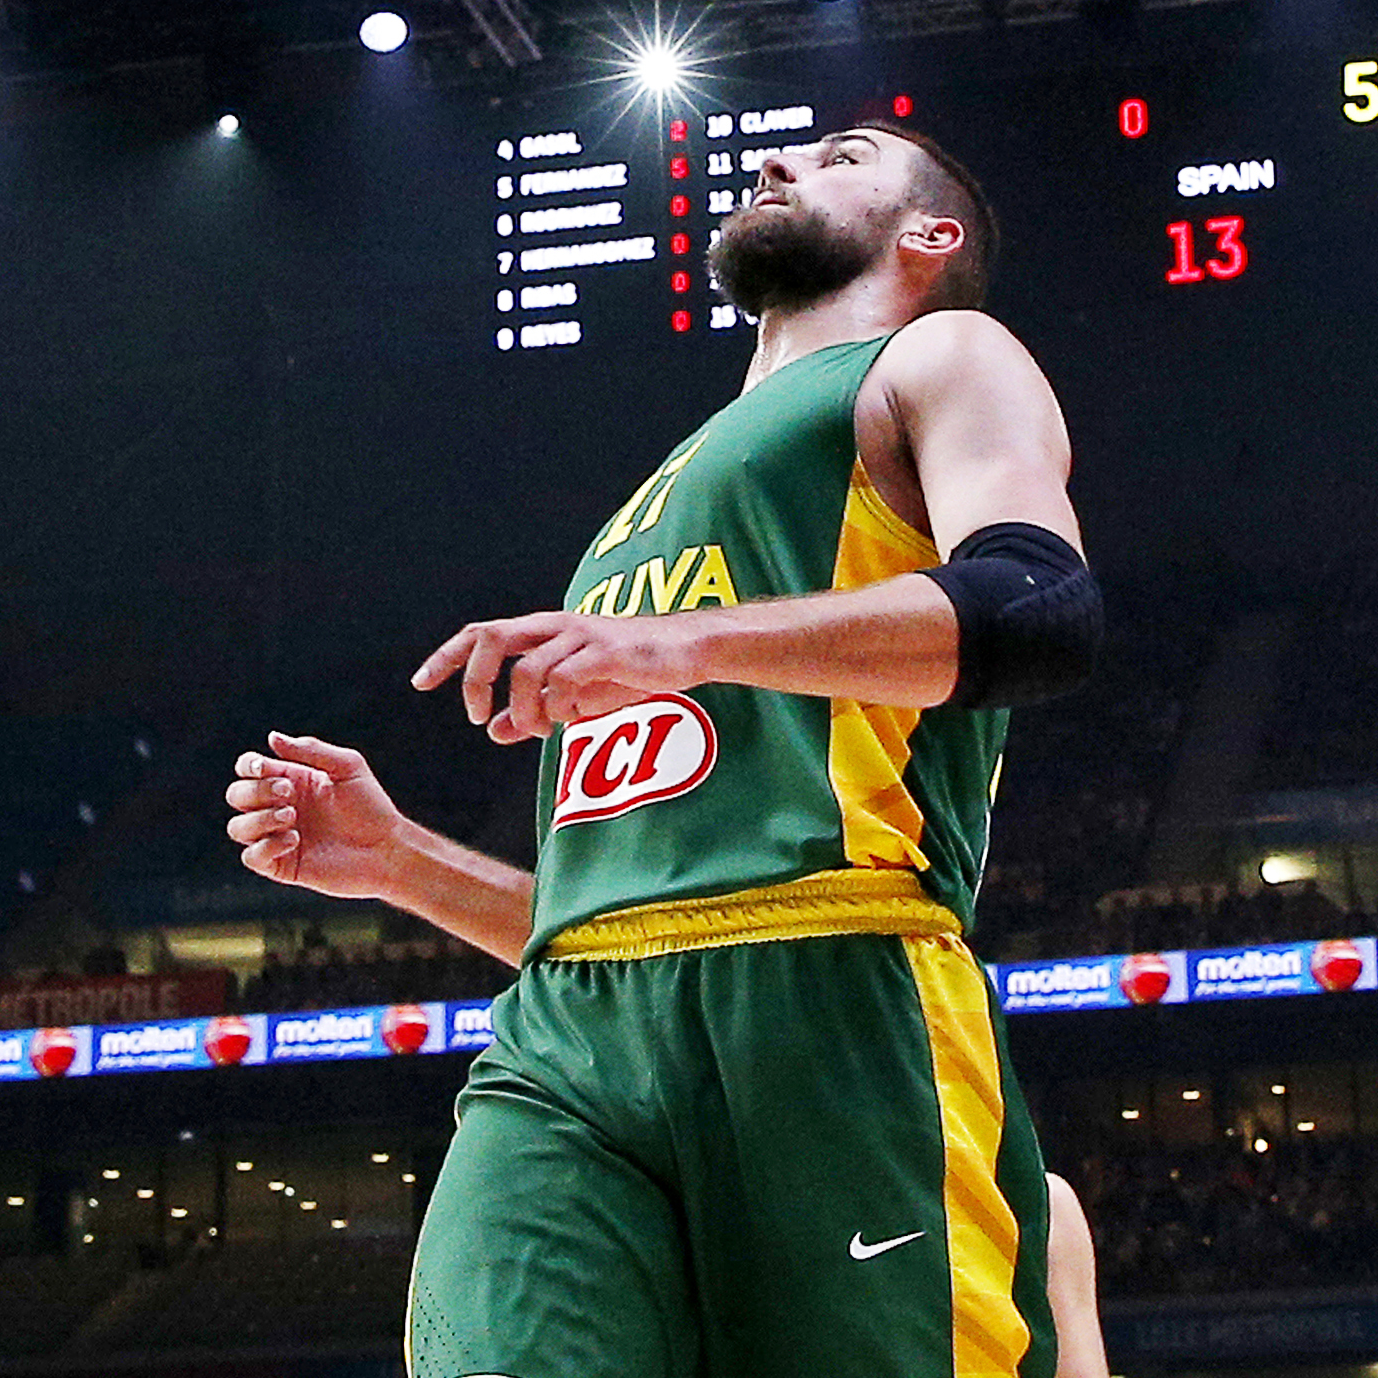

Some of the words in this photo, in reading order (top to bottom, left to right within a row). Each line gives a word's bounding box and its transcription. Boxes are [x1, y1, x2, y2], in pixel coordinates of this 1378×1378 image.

[1342, 60, 1378, 123] 5
[1119, 98, 1149, 139] 0
[1177, 159, 1276, 197] SPAIN
[1165, 215, 1249, 285] 13
[1006, 963, 1112, 995] molten
[1197, 950, 1303, 982] molten
[99, 1025, 197, 1056] molten
[275, 1013, 373, 1044] molten
